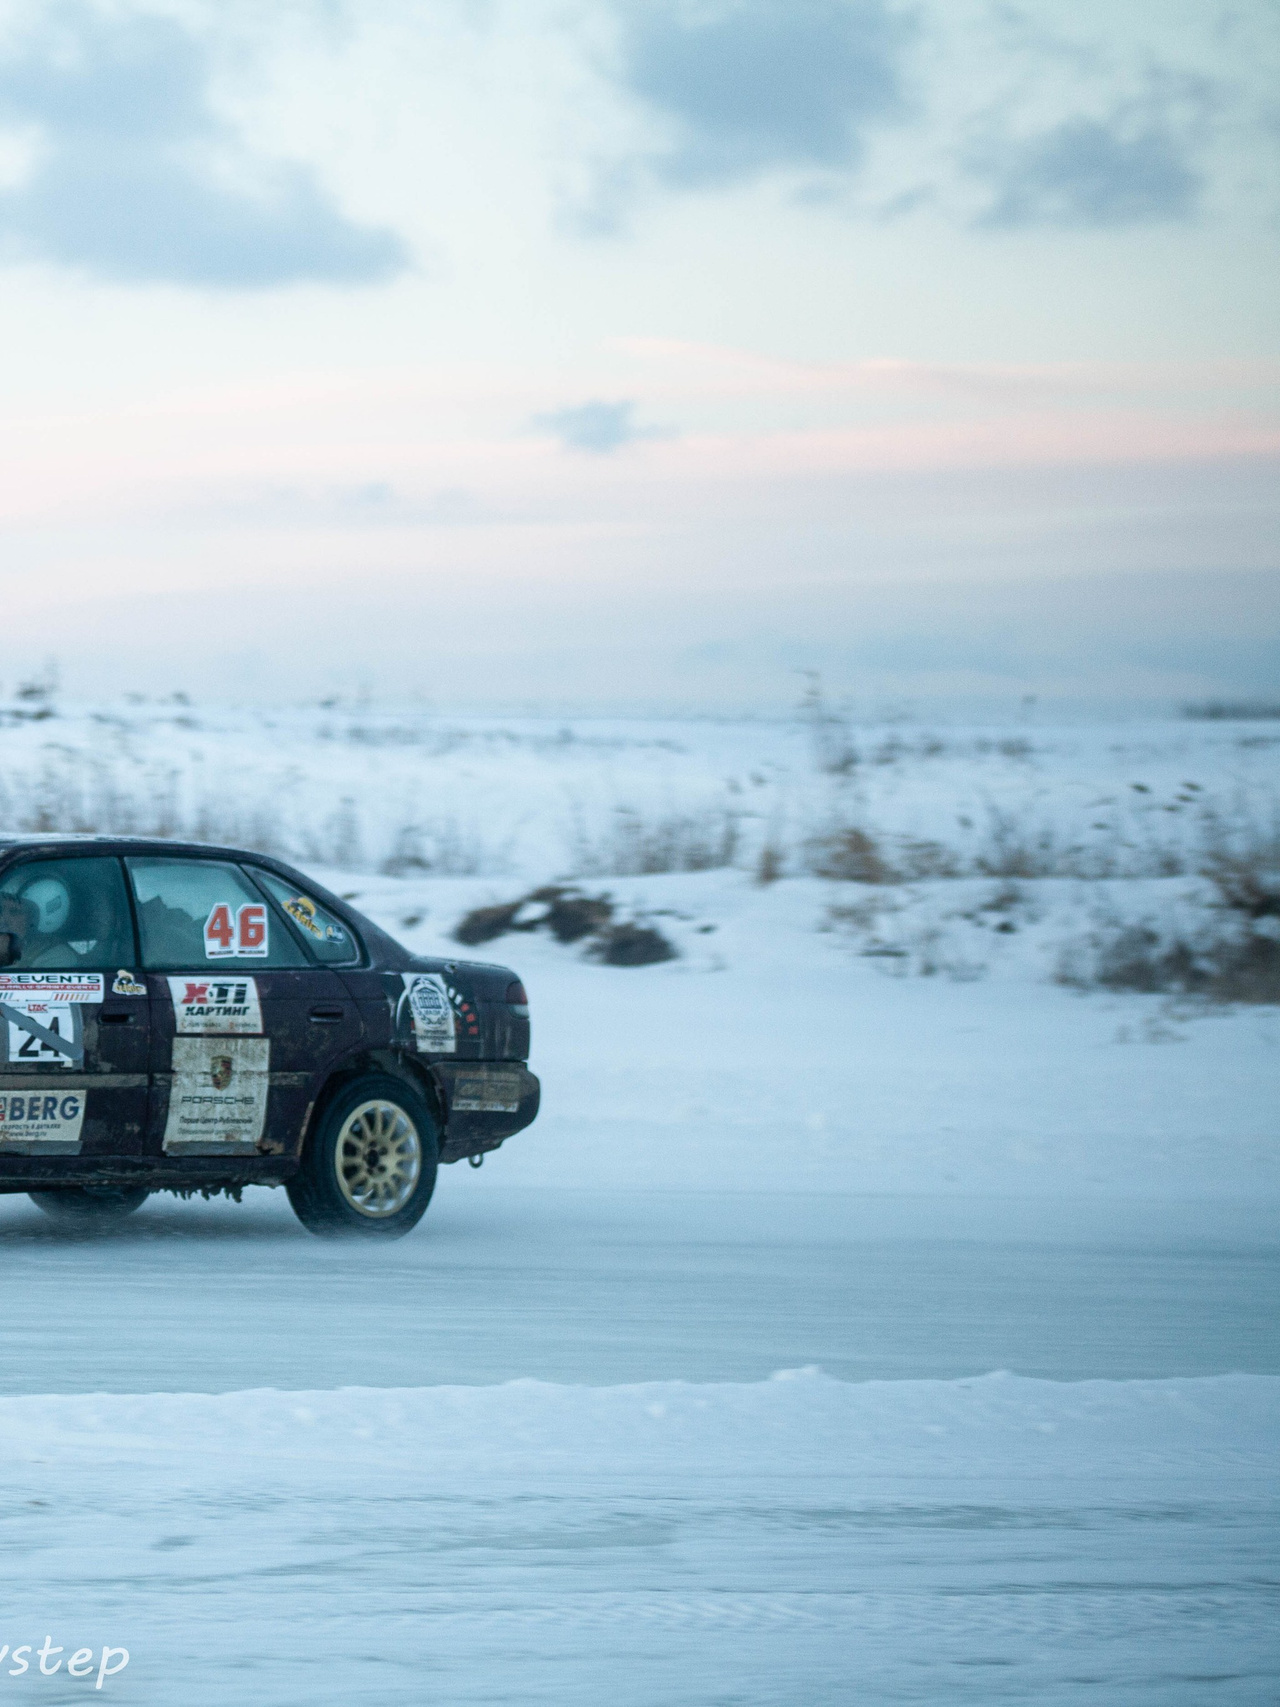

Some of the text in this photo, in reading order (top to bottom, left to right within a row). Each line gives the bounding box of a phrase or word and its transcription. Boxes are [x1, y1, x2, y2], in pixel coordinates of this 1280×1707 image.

[207, 906, 265, 947] 46
[17, 975, 100, 984] EVENTS
[185, 1006, 250, 1016] КАРТИНГ
[181, 1096, 254, 1104] PORSCHE
[9, 1096, 80, 1121] BERG
